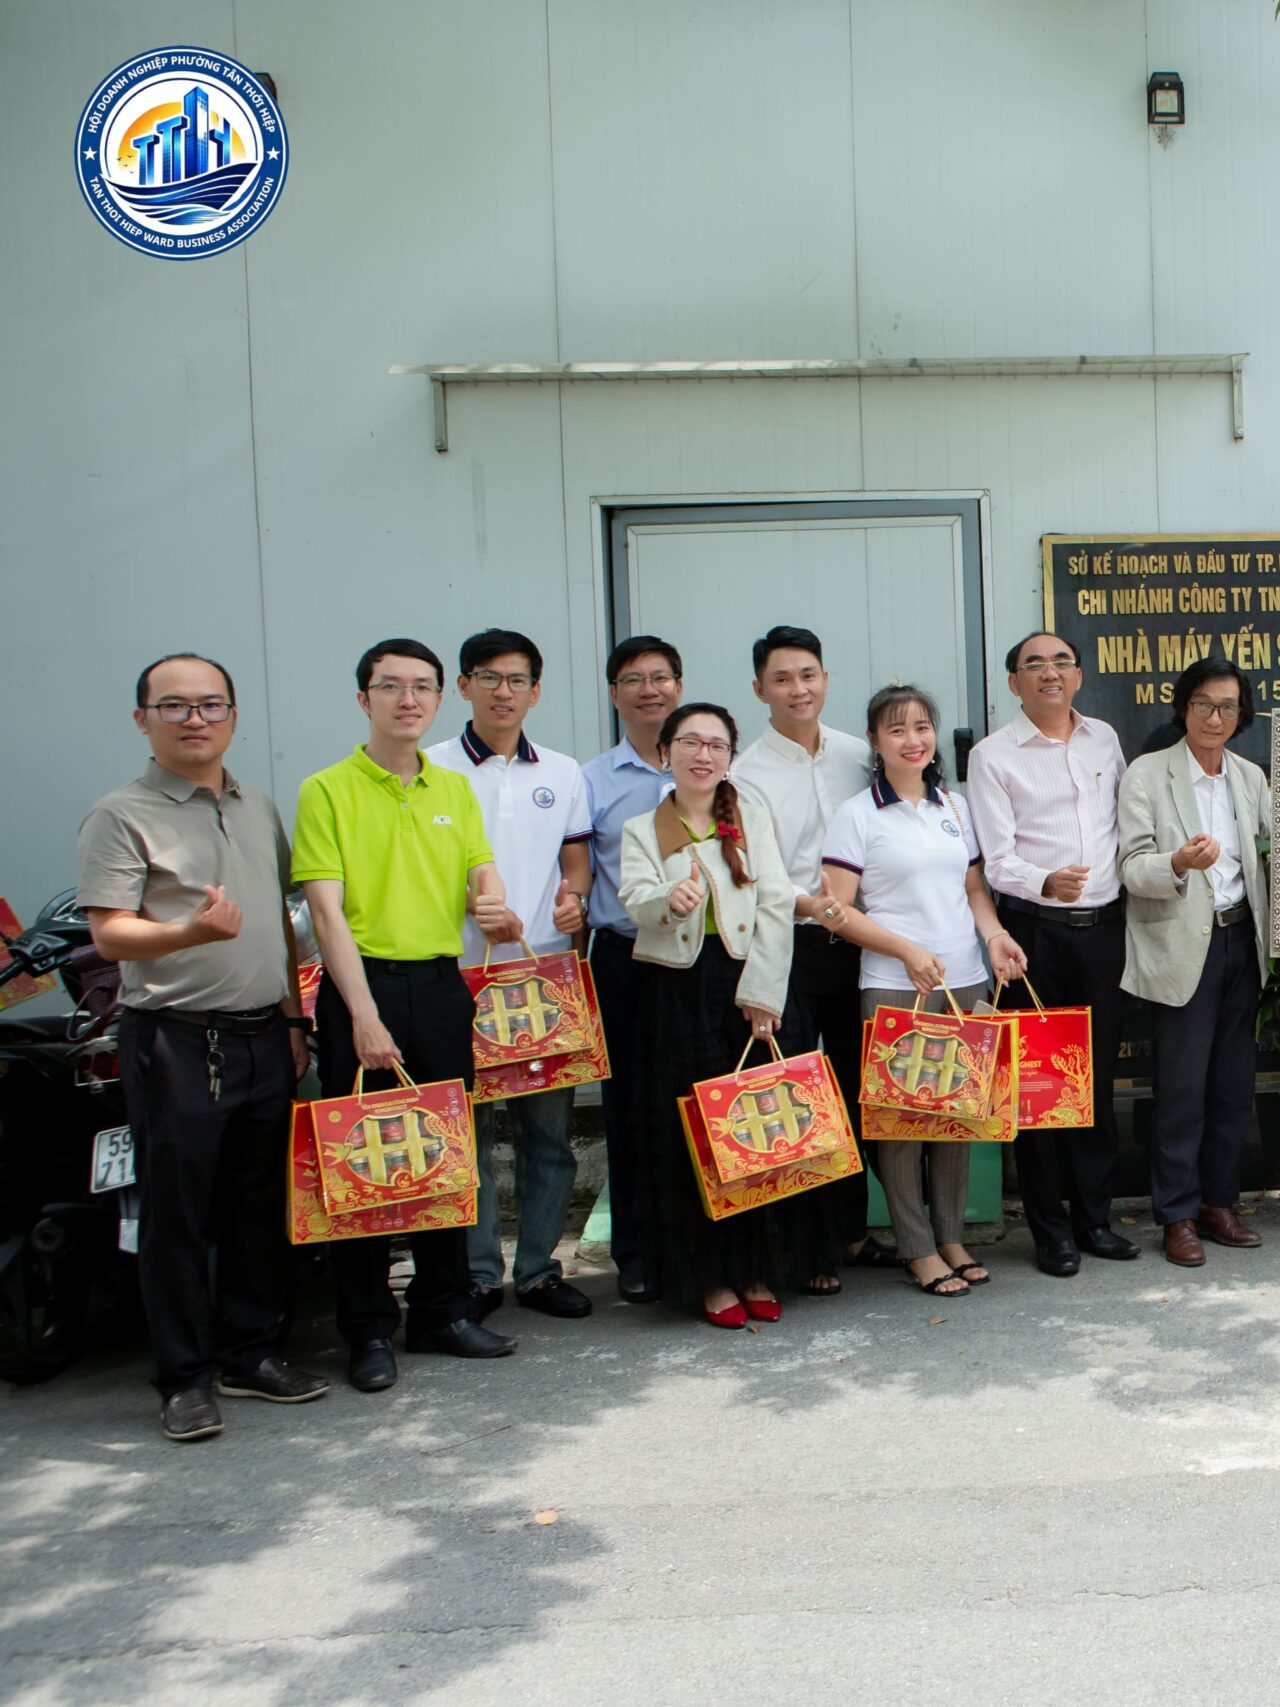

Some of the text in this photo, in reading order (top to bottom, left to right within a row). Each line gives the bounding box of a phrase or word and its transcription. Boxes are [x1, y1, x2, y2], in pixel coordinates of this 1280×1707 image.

[1068, 549, 1088, 575] SỞ
[1093, 549, 1113, 575] KẾ
[1117, 553, 1168, 579] HOẠCH
[1174, 551, 1192, 574] VÀ
[1197, 548, 1225, 574] ĐẦU
[1231, 552, 1251, 574] TƯ
[1078, 589, 1107, 615] CHI
[1112, 583, 1174, 615] NHÁNH
[1178, 582, 1226, 613] CÔNG
[1231, 587, 1253, 612] TY
[1097, 628, 1153, 674] NHÀ
[1158, 625, 1212, 672] MÁY
[1220, 623, 1271, 670] YẾN
[1135, 682, 1176, 704] MS
